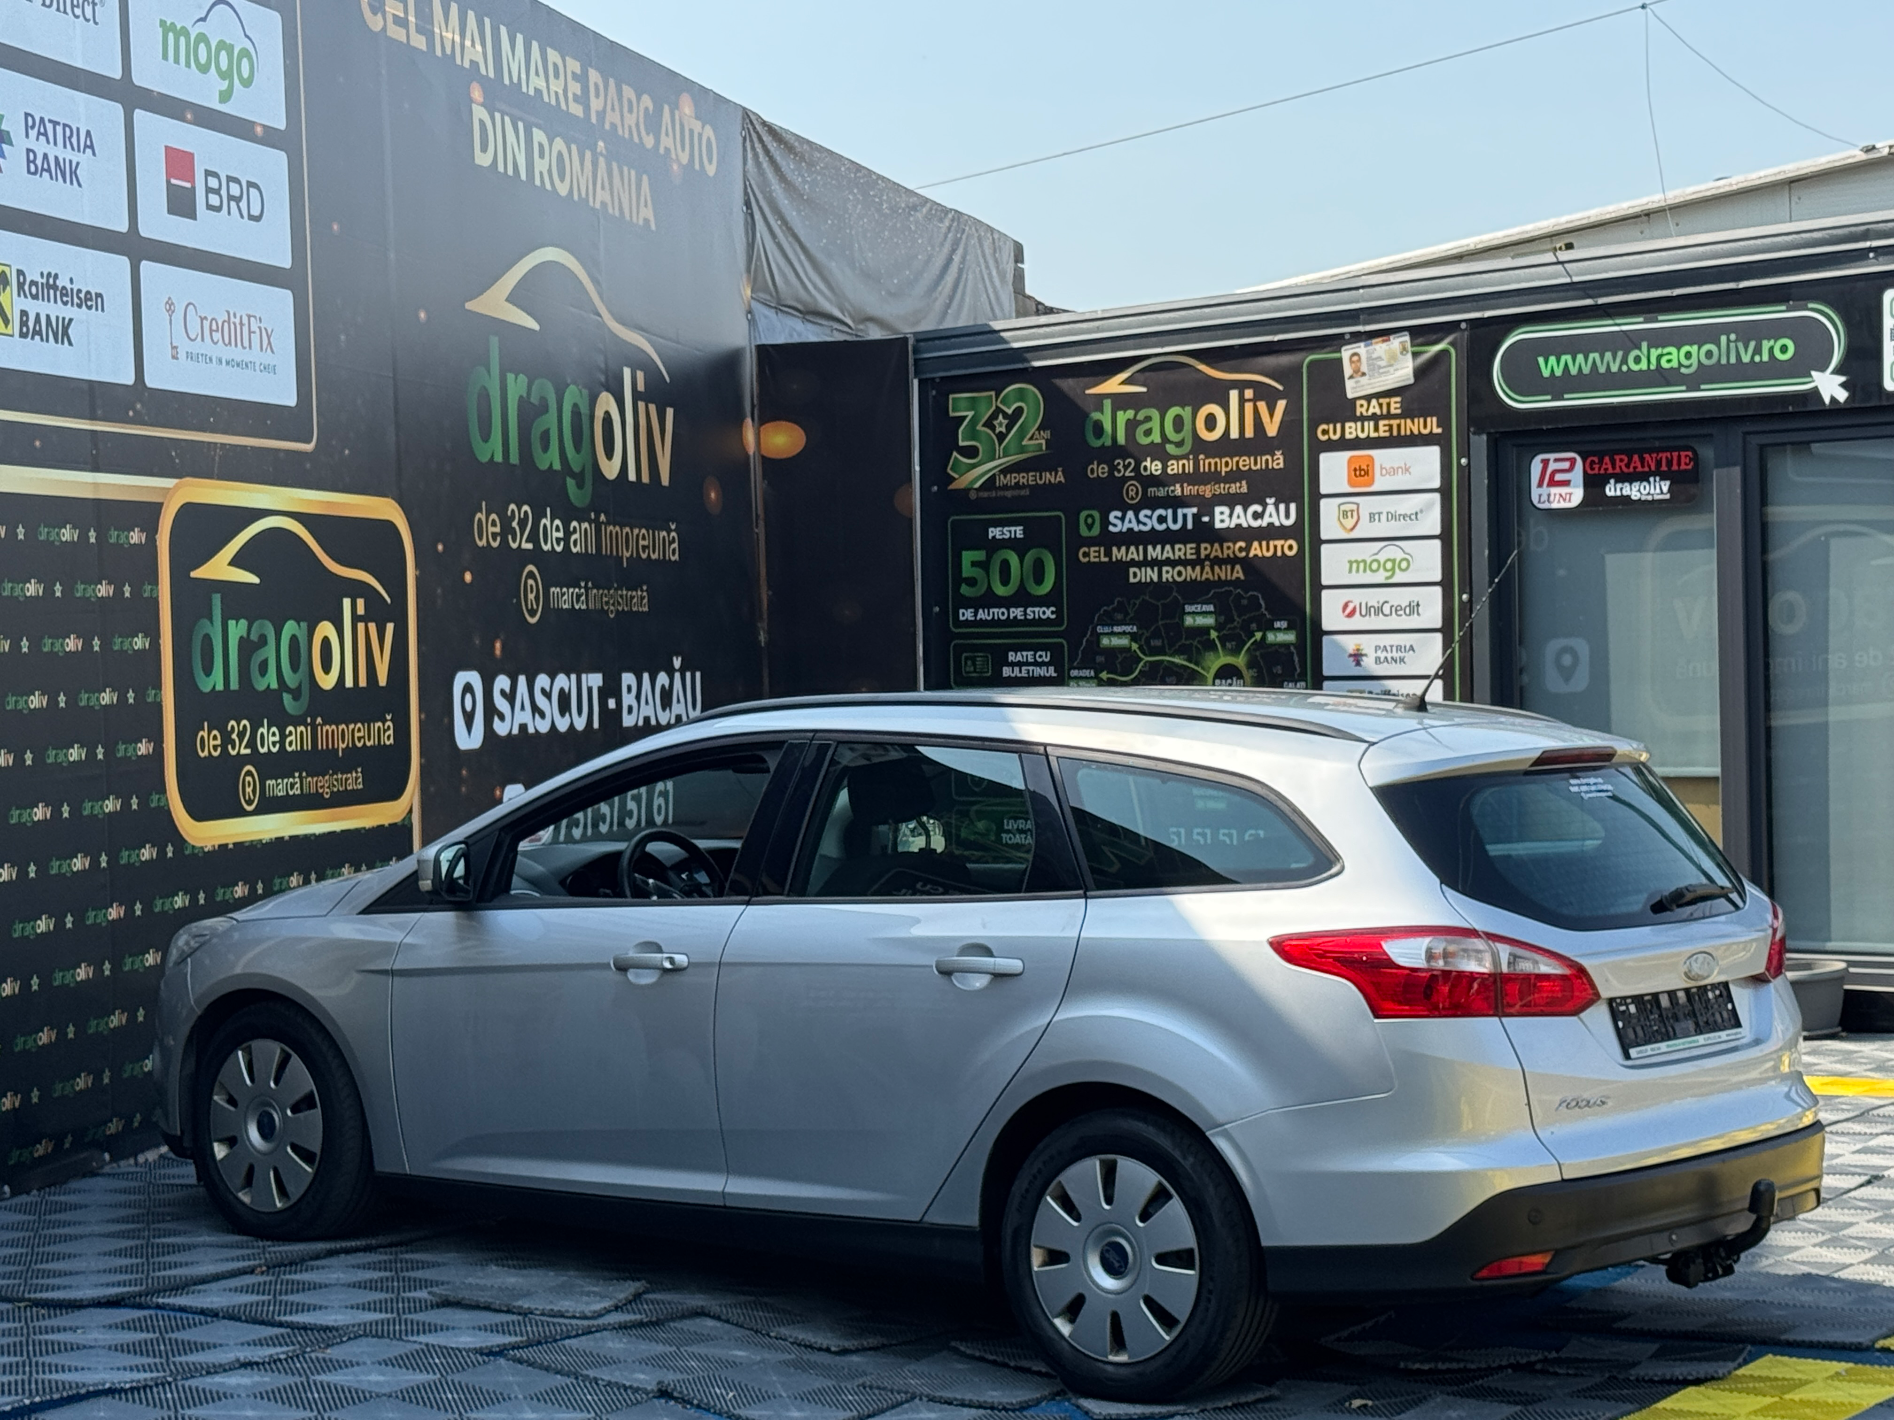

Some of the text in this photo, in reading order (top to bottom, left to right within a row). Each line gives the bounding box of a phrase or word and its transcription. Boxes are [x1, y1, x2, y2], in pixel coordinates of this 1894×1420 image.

[159, 19, 255, 104] mogo
[360, 0, 718, 178] CEL MAI MARE PARC AUTO
[23, 111, 97, 158] PATRIA
[25, 148, 82, 189] BANK
[471, 103, 656, 231] DIN ROMÂNIA
[204, 169, 265, 223] BRD
[16, 268, 105, 313] Raiffeisen
[19, 309, 74, 347] BANK
[183, 301, 275, 355] CreditFix
[185, 350, 214, 366] PRIETEN
[215, 356, 223, 367] IN
[225, 358, 257, 373] MOMENTE
[1538, 333, 1795, 379] www.dragoliv.ro
[467, 335, 675, 508] dragoliv
[1355, 396, 1402, 417] RATE
[947, 383, 1045, 479] 32
[1085, 388, 1288, 456] dragoliv
[1316, 416, 1443, 441] CU BULETINUL
[1087, 450, 1285, 479] de 32 de ani împreună
[1352, 462, 1412, 478] tbi bank
[1536, 456, 1577, 489] 12
[1584, 451, 1694, 475] GARANTIE
[1147, 483, 1182, 498] marcă
[1183, 480, 1248, 498] înregistrată
[1537, 492, 1574, 505] LUNI
[1605, 476, 1671, 500] dragoliv
[1107, 507, 1199, 533] SASCUT
[1213, 497, 1298, 530] BACĂU
[1368, 511, 1383, 524] BT
[37, 523, 147, 547] dragoliv dragoliv
[473, 500, 680, 568] de 32 de ani împreună
[988, 525, 1024, 540] PESTE
[1078, 538, 1299, 563] CEL MAI MARE PARC AUTO
[959, 548, 1056, 597] 500
[1128, 561, 1245, 584] DIN ROMÂNIA
[1347, 554, 1412, 581] mogo
[2, 578, 114, 601] dragoliv dragoliv
[550, 581, 587, 610] marcă
[588, 581, 649, 619] înregistrată
[958, 606, 1057, 621] DE AUTO PE STOC
[1358, 599, 1421, 619] UniCredit
[42, 632, 150, 656] dragoliv dragoliv
[191, 593, 395, 715] dragoliv
[1008, 650, 1051, 663] RATE CU
[1374, 644, 1416, 654] PATRIA
[1002, 665, 1058, 678] BULETINUL
[1374, 656, 1407, 665] BANK
[5, 690, 48, 713] dragoliv
[78, 687, 118, 710] dragoliv
[492, 673, 603, 737] SASCUT
[620, 655, 702, 728] BACĂU
[196, 713, 395, 758] de 32 de ani împreună
[45, 738, 154, 766] dragoliv dragoliv
[265, 773, 300, 798] marcă
[302, 767, 364, 799] înregistrată
[8, 802, 52, 826] dragoliv
[82, 794, 122, 818] dragoliv
[652, 779, 674, 827] 61
[50, 853, 91, 877] dragoliv
[119, 843, 158, 867] dragoliv
[12, 914, 56, 939] dragoliv
[85, 902, 126, 926] dragoliv
[153, 890, 190, 914] dragoliv
[52, 962, 94, 987] dragoliv
